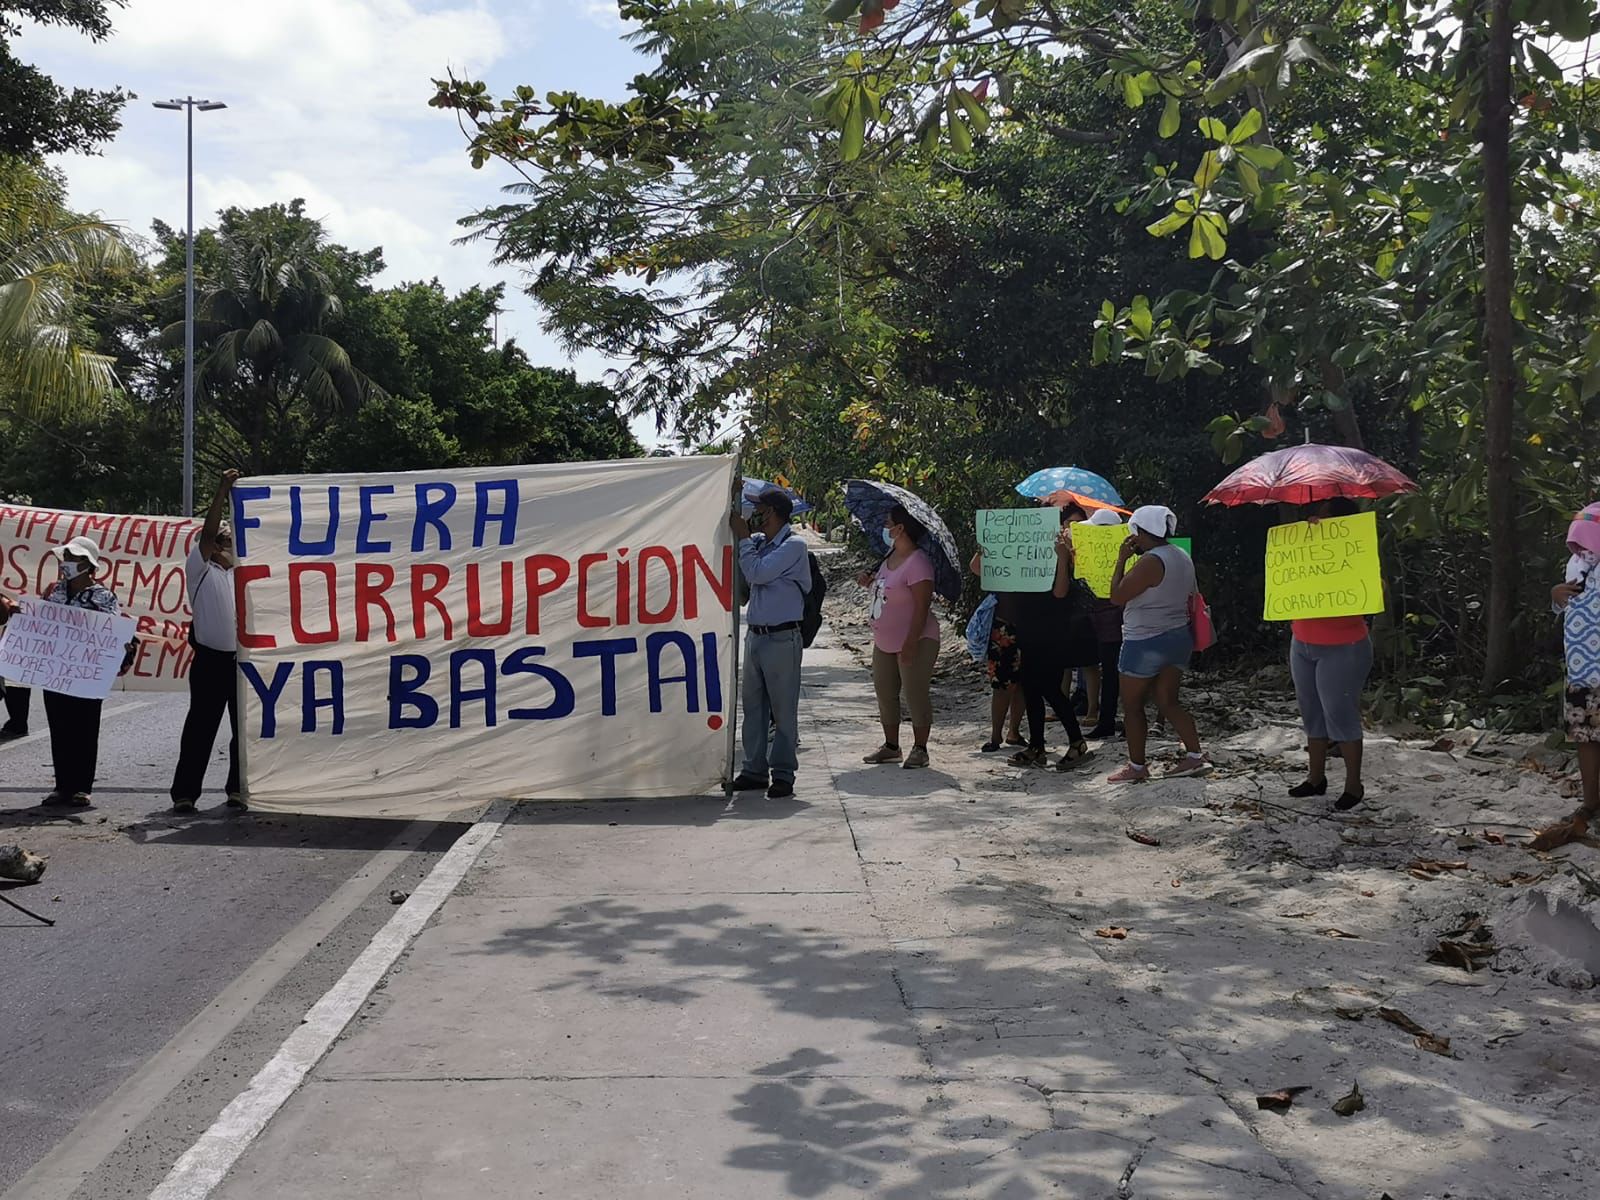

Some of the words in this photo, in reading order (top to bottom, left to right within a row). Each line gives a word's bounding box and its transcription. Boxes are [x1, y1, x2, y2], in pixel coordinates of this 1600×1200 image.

[232, 479, 519, 557] FUERA
[984, 510, 1043, 527] Pedimos
[982, 526, 1031, 544] Recibos
[1269, 523, 1299, 548] ALTO
[1303, 521, 1315, 542] A
[1321, 519, 1351, 541] LOS
[982, 546, 998, 560] De
[1266, 543, 1335, 569] COMITES
[1345, 539, 1366, 557] DE
[983, 565, 1012, 577] mas
[1272, 558, 1353, 586] COBRANZA
[39, 603, 88, 631] COLONIA
[92, 614, 113, 635] LA
[4, 632, 57, 658] FALTAN
[56, 642, 77, 662] 26
[0, 648, 55, 677] DIDORES
[58, 661, 104, 681] DESDE
[20, 668, 38, 686] EL
[41, 675, 73, 692] 2019
[238, 659, 345, 738] YA
[387, 631, 723, 731] BASTA!
